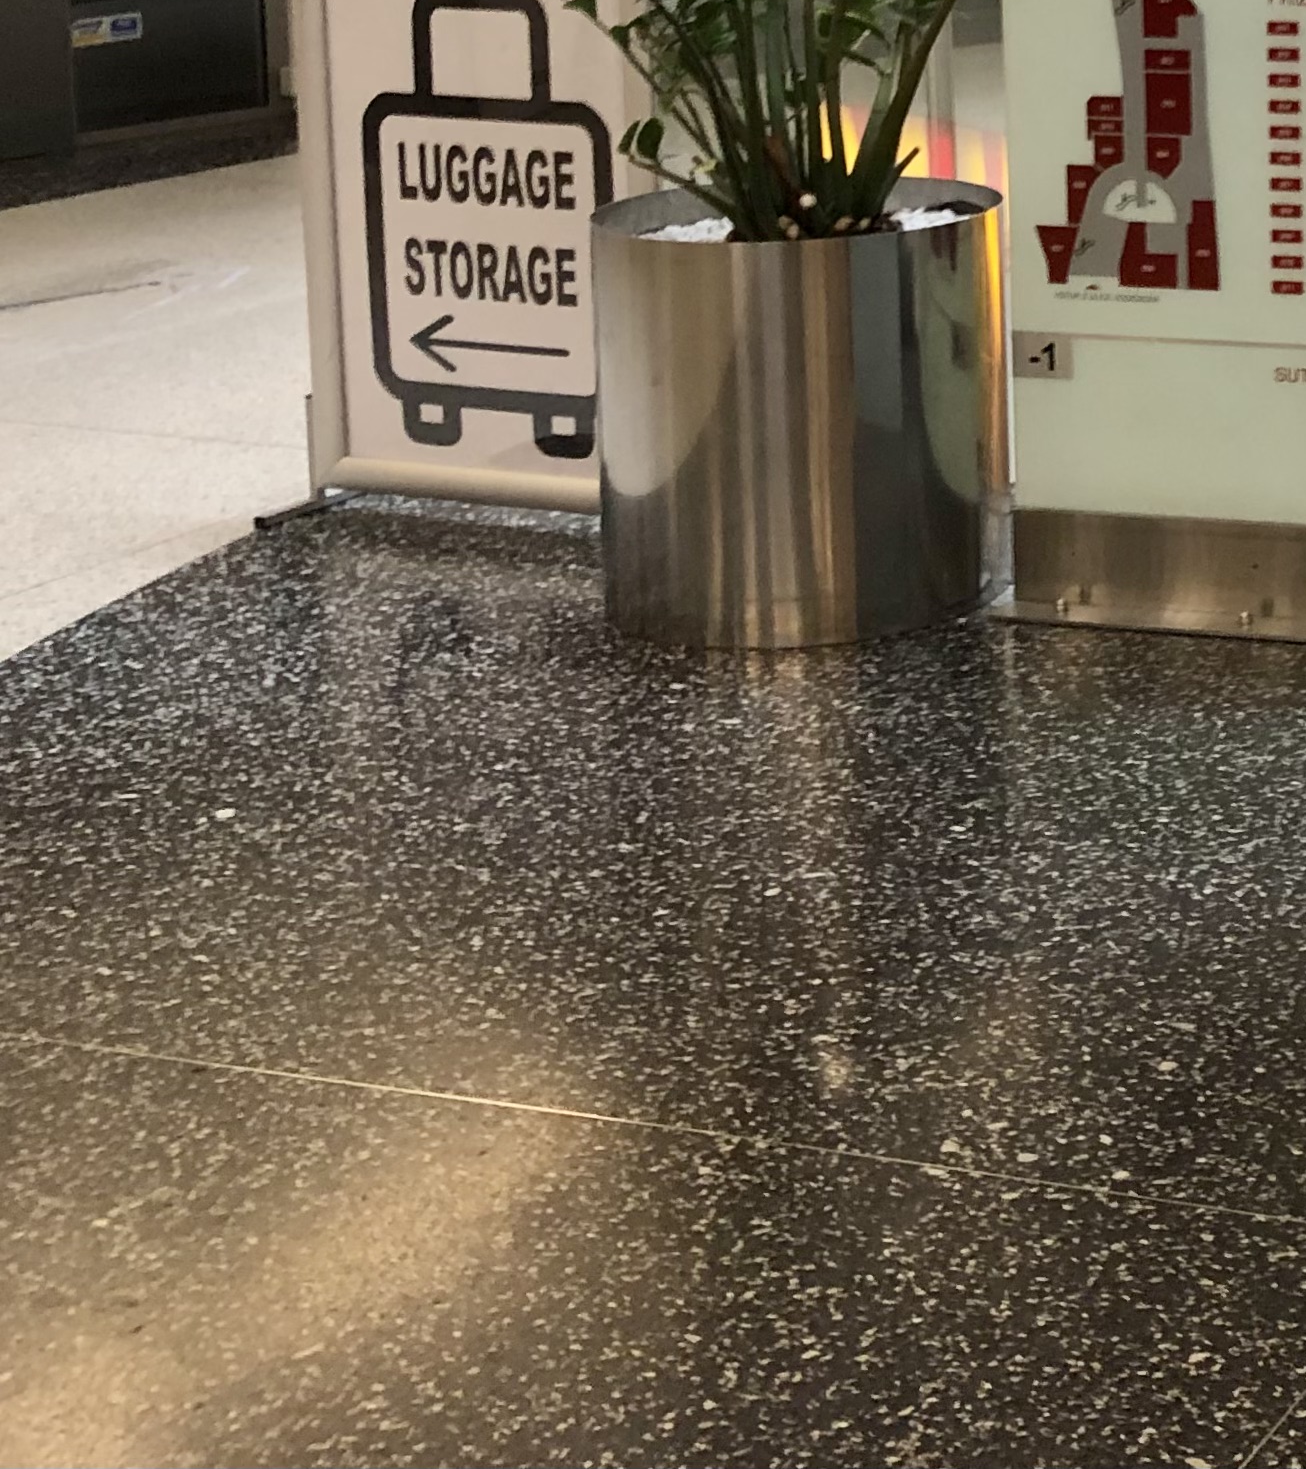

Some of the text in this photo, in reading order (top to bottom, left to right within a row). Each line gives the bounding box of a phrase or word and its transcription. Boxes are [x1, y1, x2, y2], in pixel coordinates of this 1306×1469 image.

[398, 141, 576, 210] LUGGAGE
[404, 237, 578, 307] STORAGE
[1028, 341, 1056, 372] -1
